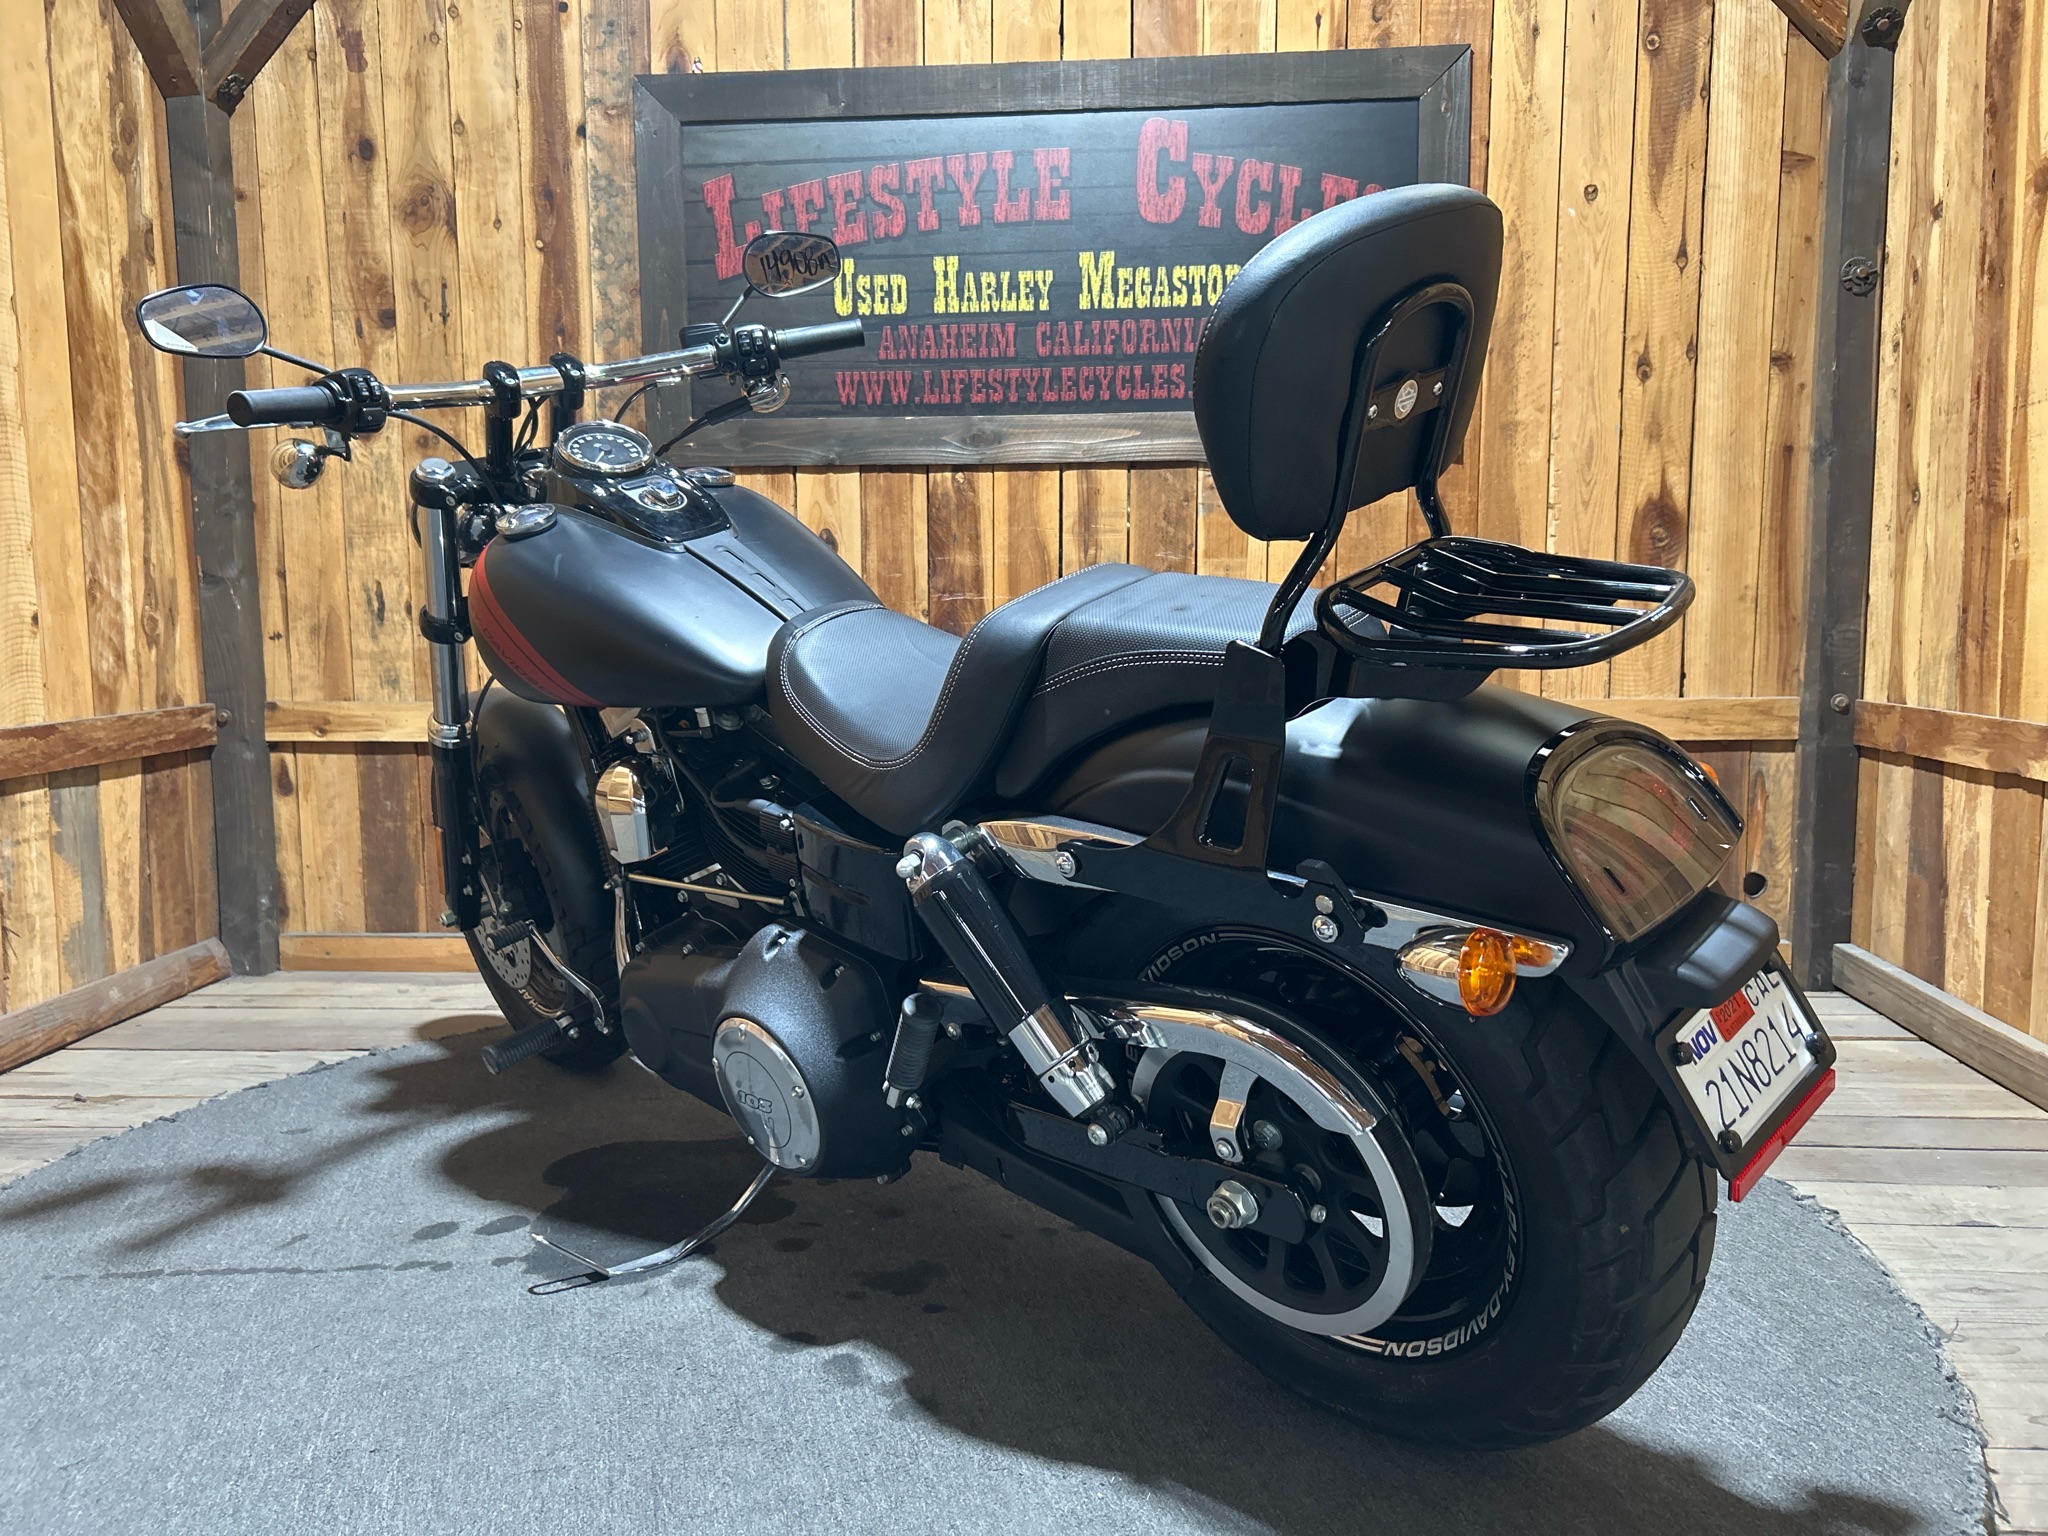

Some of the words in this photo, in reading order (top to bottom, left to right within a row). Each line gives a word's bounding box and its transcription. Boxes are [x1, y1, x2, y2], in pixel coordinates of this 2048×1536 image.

[1136, 116, 1389, 237] CYCL
[933, 255, 1054, 314] HARLEY
[878, 322, 1017, 361] ANAHEIM
[1705, 1002, 1807, 1130] 21N8214
